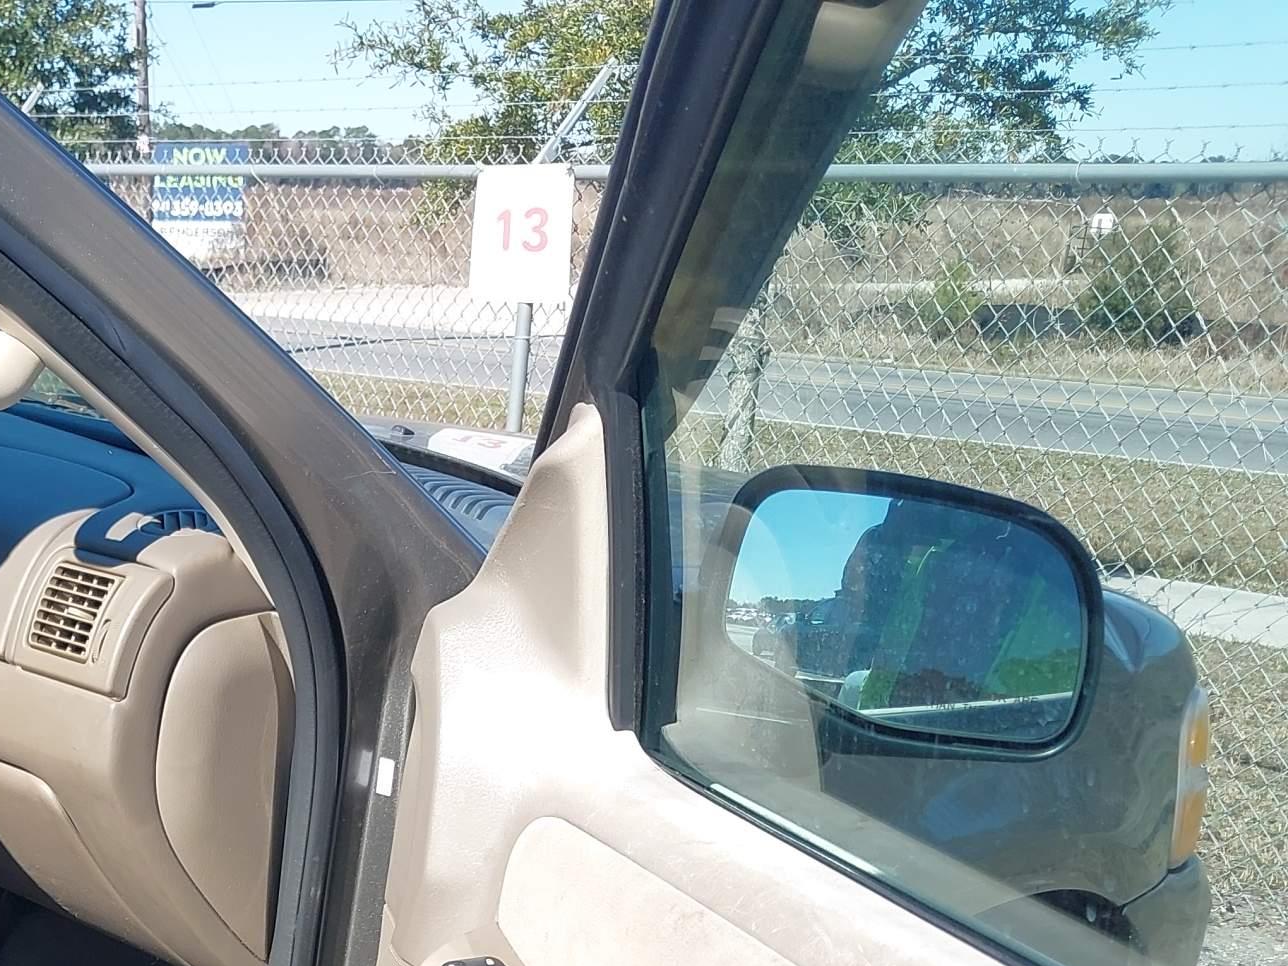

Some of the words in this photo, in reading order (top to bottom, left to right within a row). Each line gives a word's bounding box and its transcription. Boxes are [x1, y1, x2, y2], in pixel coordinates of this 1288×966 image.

[173, 146, 226, 165] NOW
[154, 174, 244, 188] LEASING
[496, 207, 549, 253] 13
